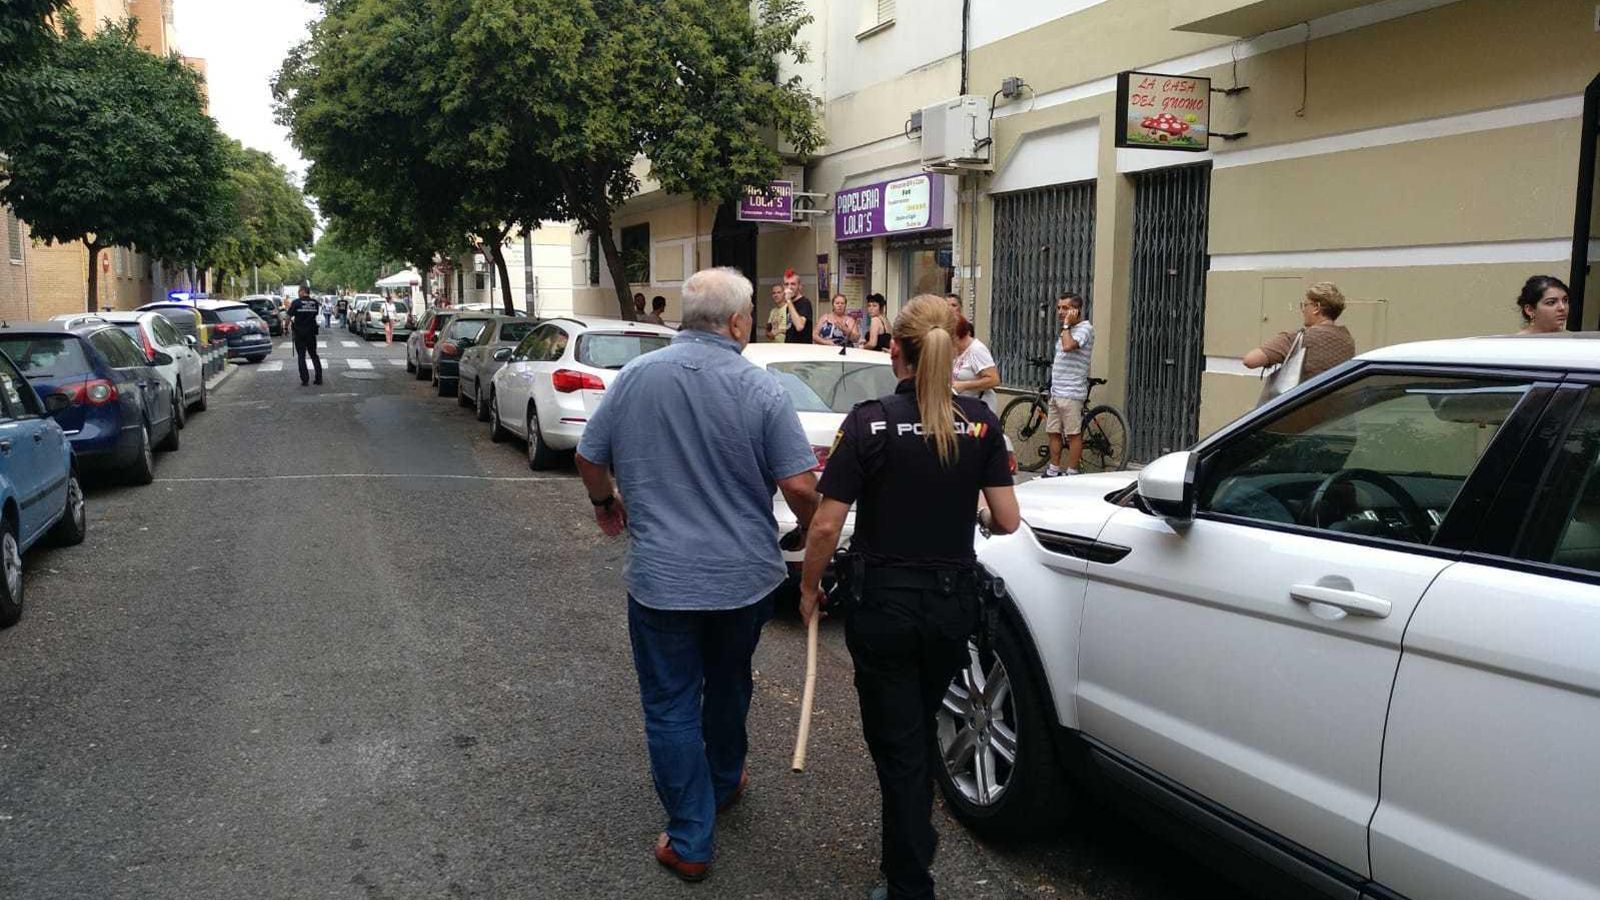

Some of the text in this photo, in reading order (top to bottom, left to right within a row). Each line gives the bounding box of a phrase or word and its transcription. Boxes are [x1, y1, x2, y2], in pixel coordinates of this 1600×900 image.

[1138, 77, 1197, 92] LA CASA
[1131, 94, 1204, 111] DEL GNOMO
[837, 188, 880, 215] PAPELERIA
